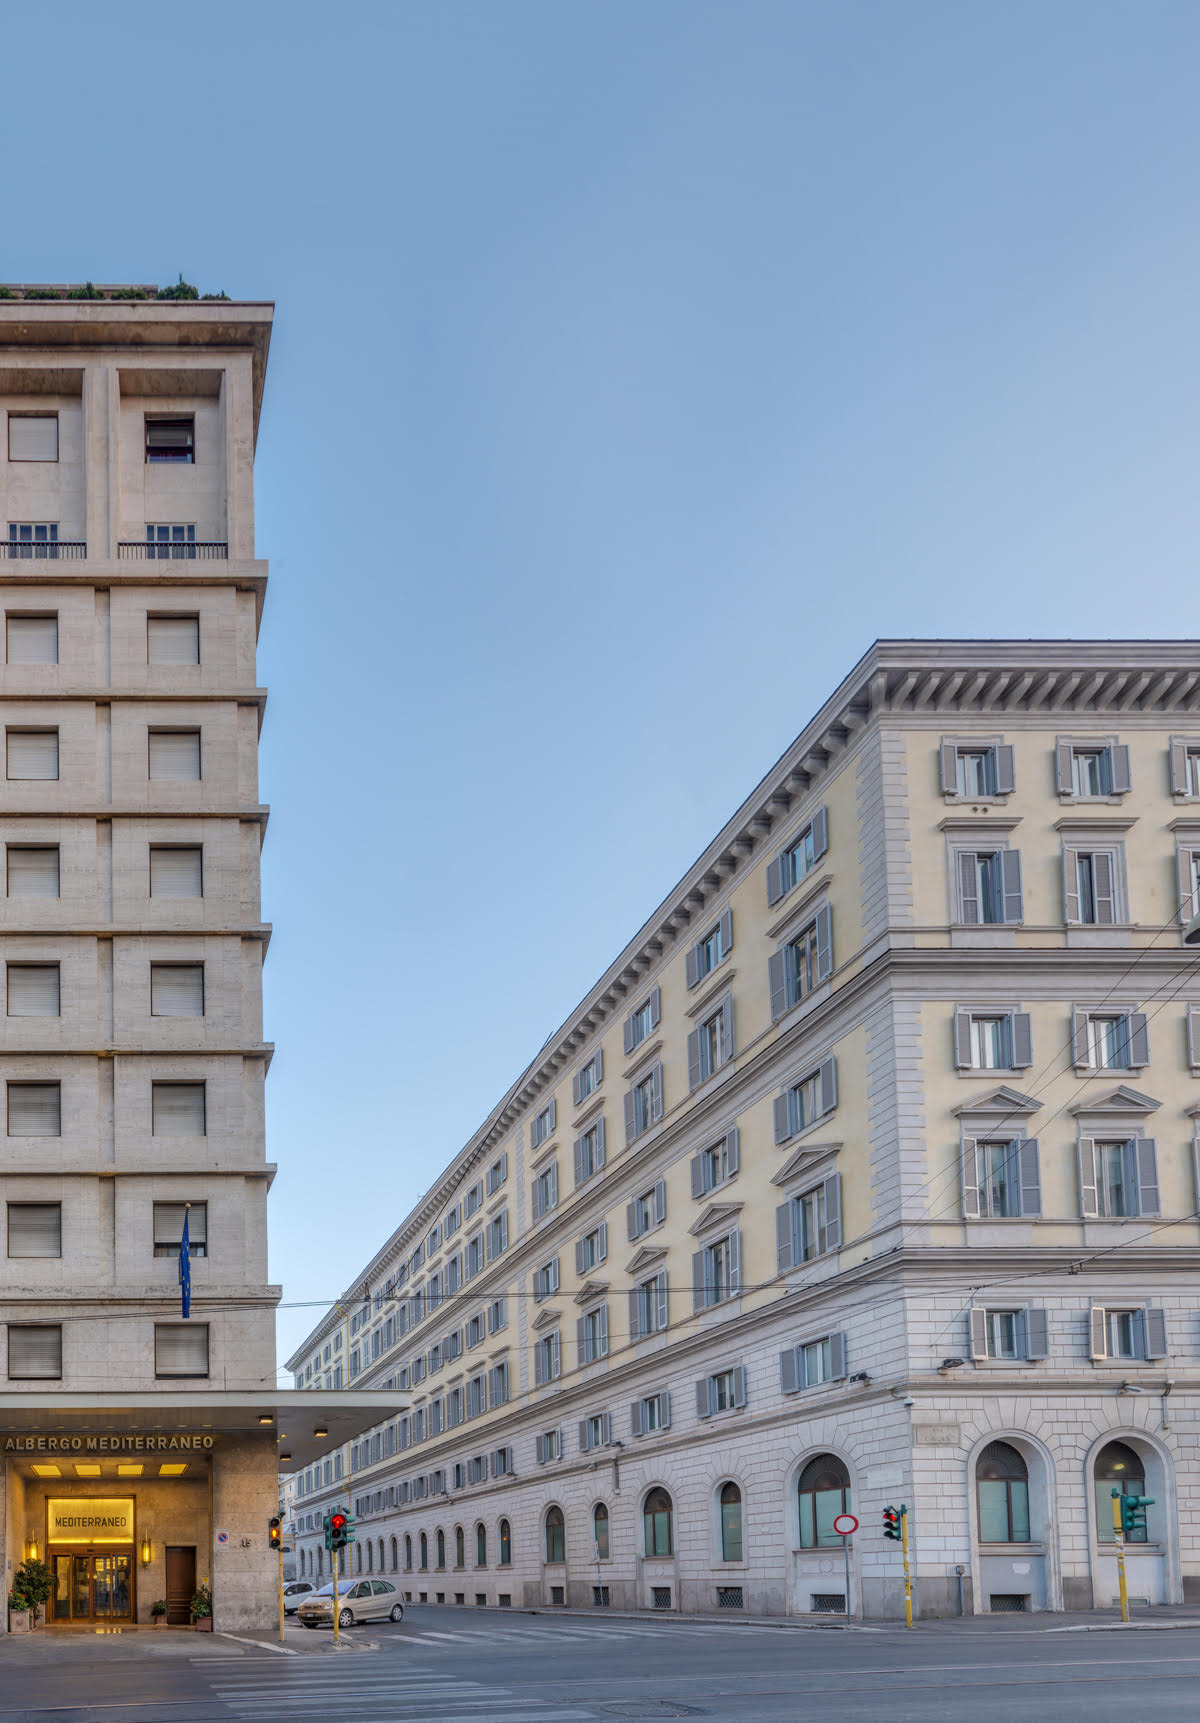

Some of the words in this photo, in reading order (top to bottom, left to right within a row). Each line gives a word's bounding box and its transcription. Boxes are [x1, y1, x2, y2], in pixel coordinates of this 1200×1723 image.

[5, 1437, 82, 1450] ALBERGO
[87, 1435, 214, 1450] MEDITERRANEO
[55, 1516, 127, 1528] MEDITERRANEO
